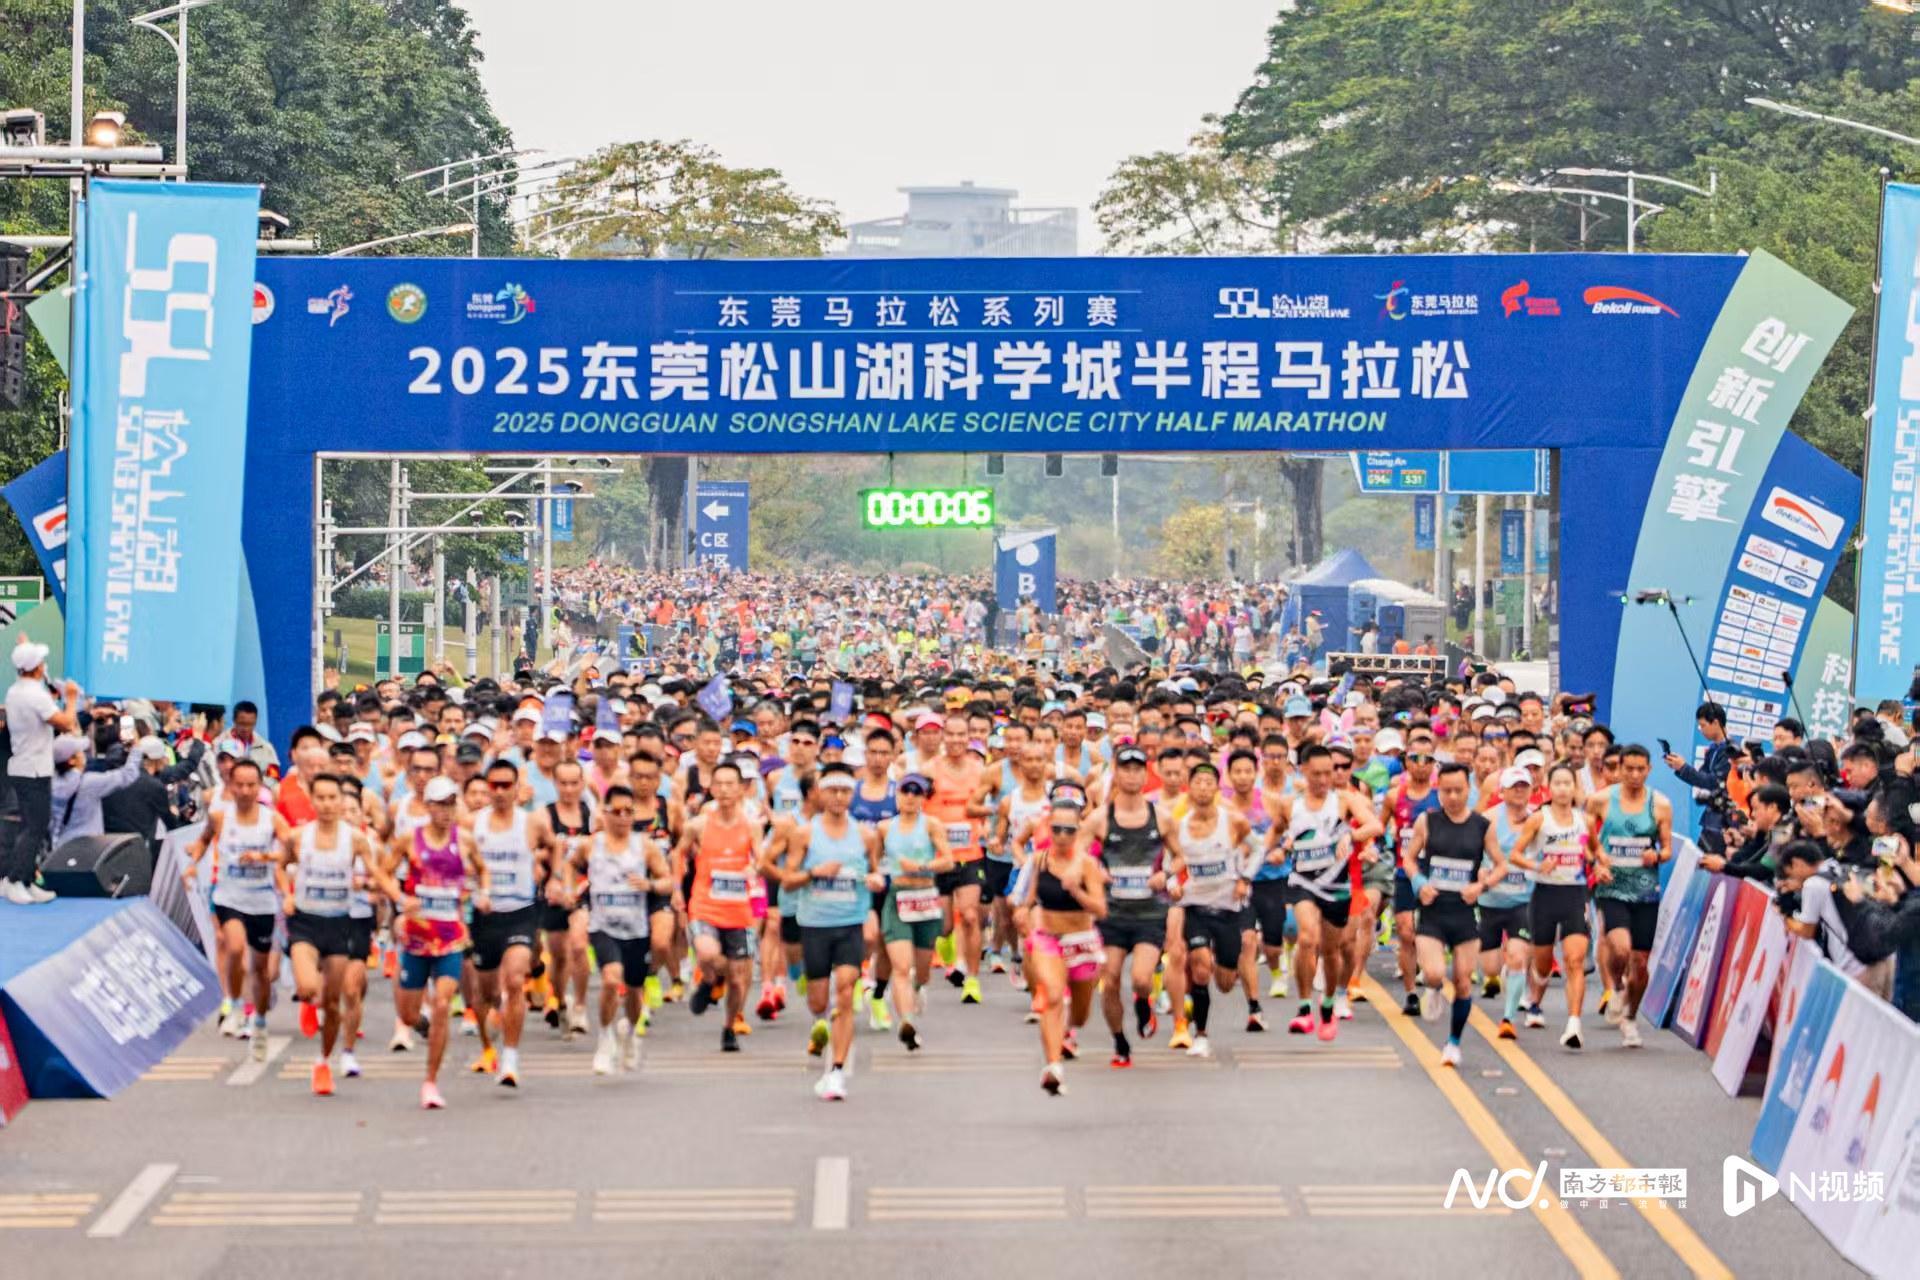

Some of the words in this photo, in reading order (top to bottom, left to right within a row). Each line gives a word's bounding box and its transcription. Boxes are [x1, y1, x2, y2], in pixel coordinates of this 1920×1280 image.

[718, 296, 1117, 327] 东莞马拉松系列赛
[1410, 294, 1478, 308] 东莞马拉松
[408, 340, 1470, 401] 2025东莞松山湖科学城半程马拉松
[493, 412, 554, 432] 2025
[561, 412, 718, 432] DONGGUAN
[730, 412, 882, 432] SONGSHAN
[889, 412, 956, 432] LAKE
[963, 412, 1082, 432] SCIENCE
[1089, 412, 1152, 432] CITY
[1155, 412, 1228, 432] HALF
[1233, 411, 1387, 432] MARATHON
[1667, 316, 1814, 524] 创新引擎
[134, 408, 191, 593] 松山湖
[867, 491, 991, 526] 00:00:06
[701, 532, 729, 548] C区
